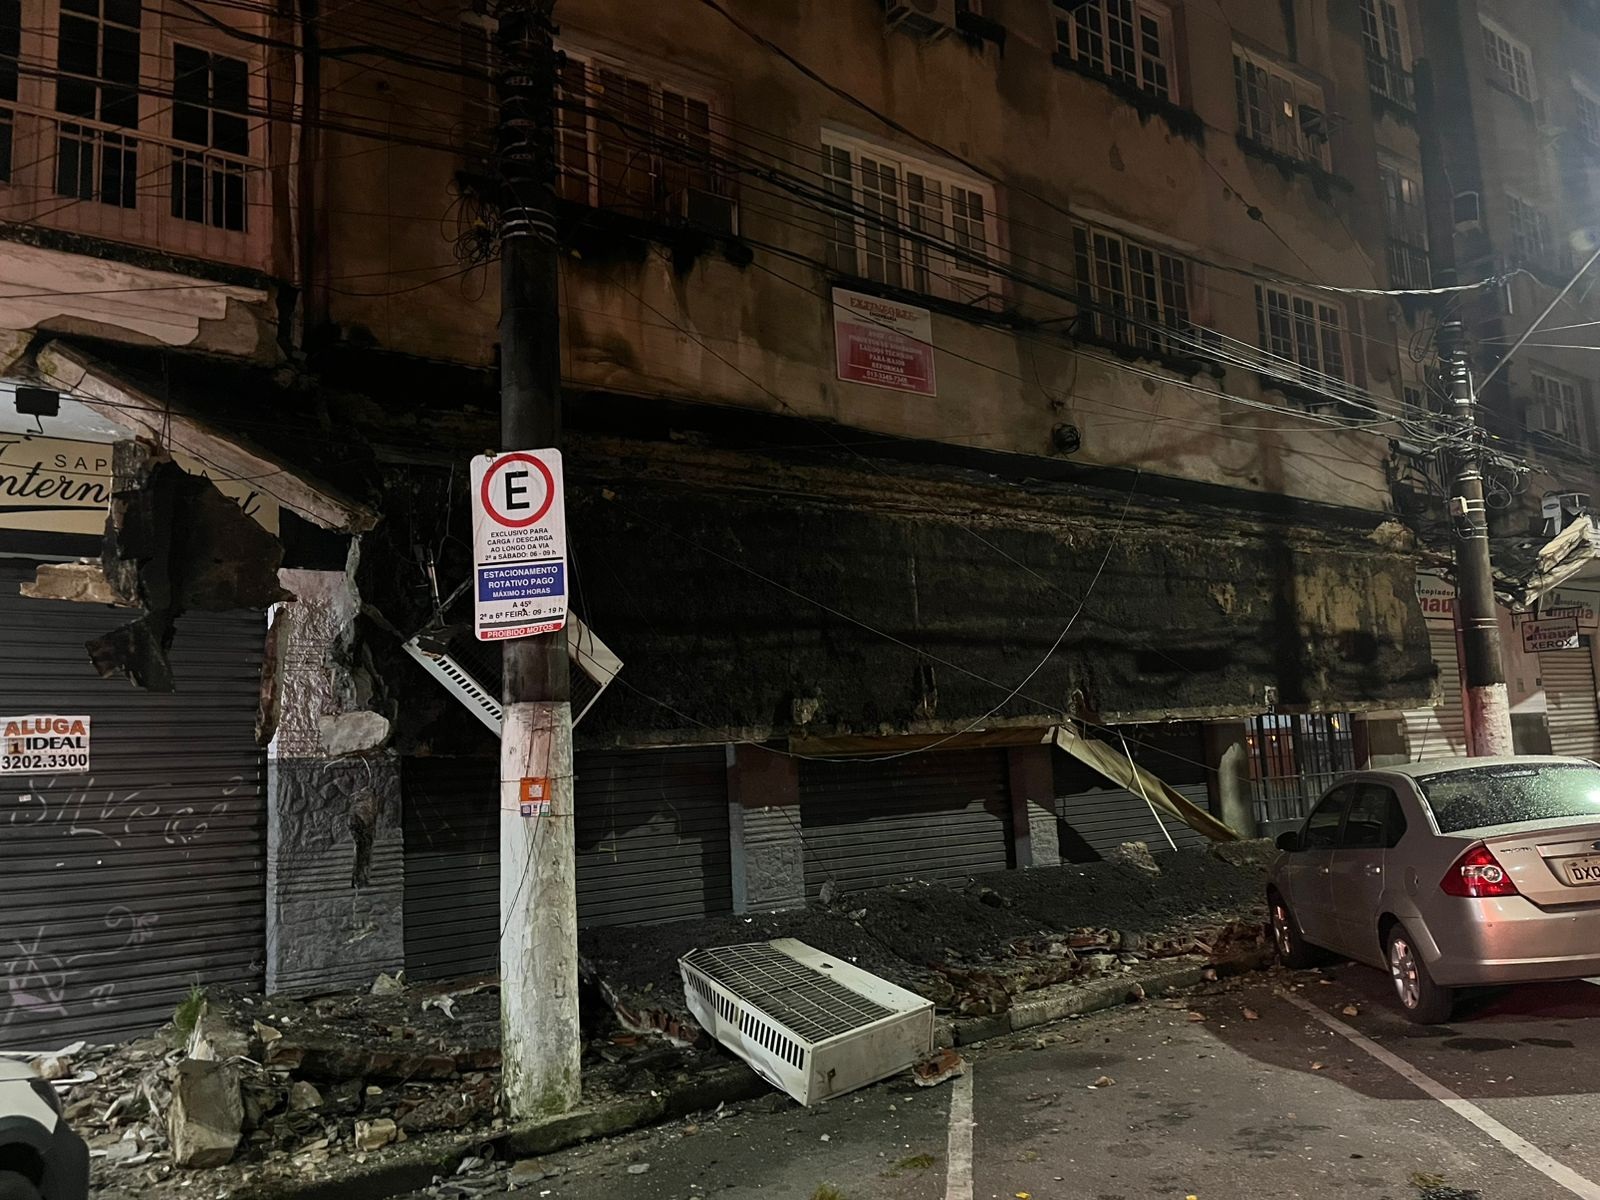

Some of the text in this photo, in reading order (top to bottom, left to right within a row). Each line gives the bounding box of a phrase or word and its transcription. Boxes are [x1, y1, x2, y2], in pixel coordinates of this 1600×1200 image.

[505, 471, 530, 510] E
[491, 529, 528, 538] EXCLUSIVO
[487, 538, 511, 546] CARGA
[516, 535, 553, 543] DESCARGA
[501, 544, 526, 552] LONGO
[483, 566, 558, 579] ESTACIONAMENTO
[488, 576, 554, 589] ROTATIVO PAGO
[492, 589, 520, 598] MÁXIMO
[527, 587, 551, 595] HORAS
[505, 609, 531, 618] FEIRA:
[532, 608, 542, 616] 09
[487, 624, 554, 638] PROIBIDO MOTOS
[1531, 639, 1572, 649] XEROX
[4, 718, 86, 736] ALUGA
[26, 737, 87, 750] IDEAL
[1, 754, 87, 770] 3202.3300
